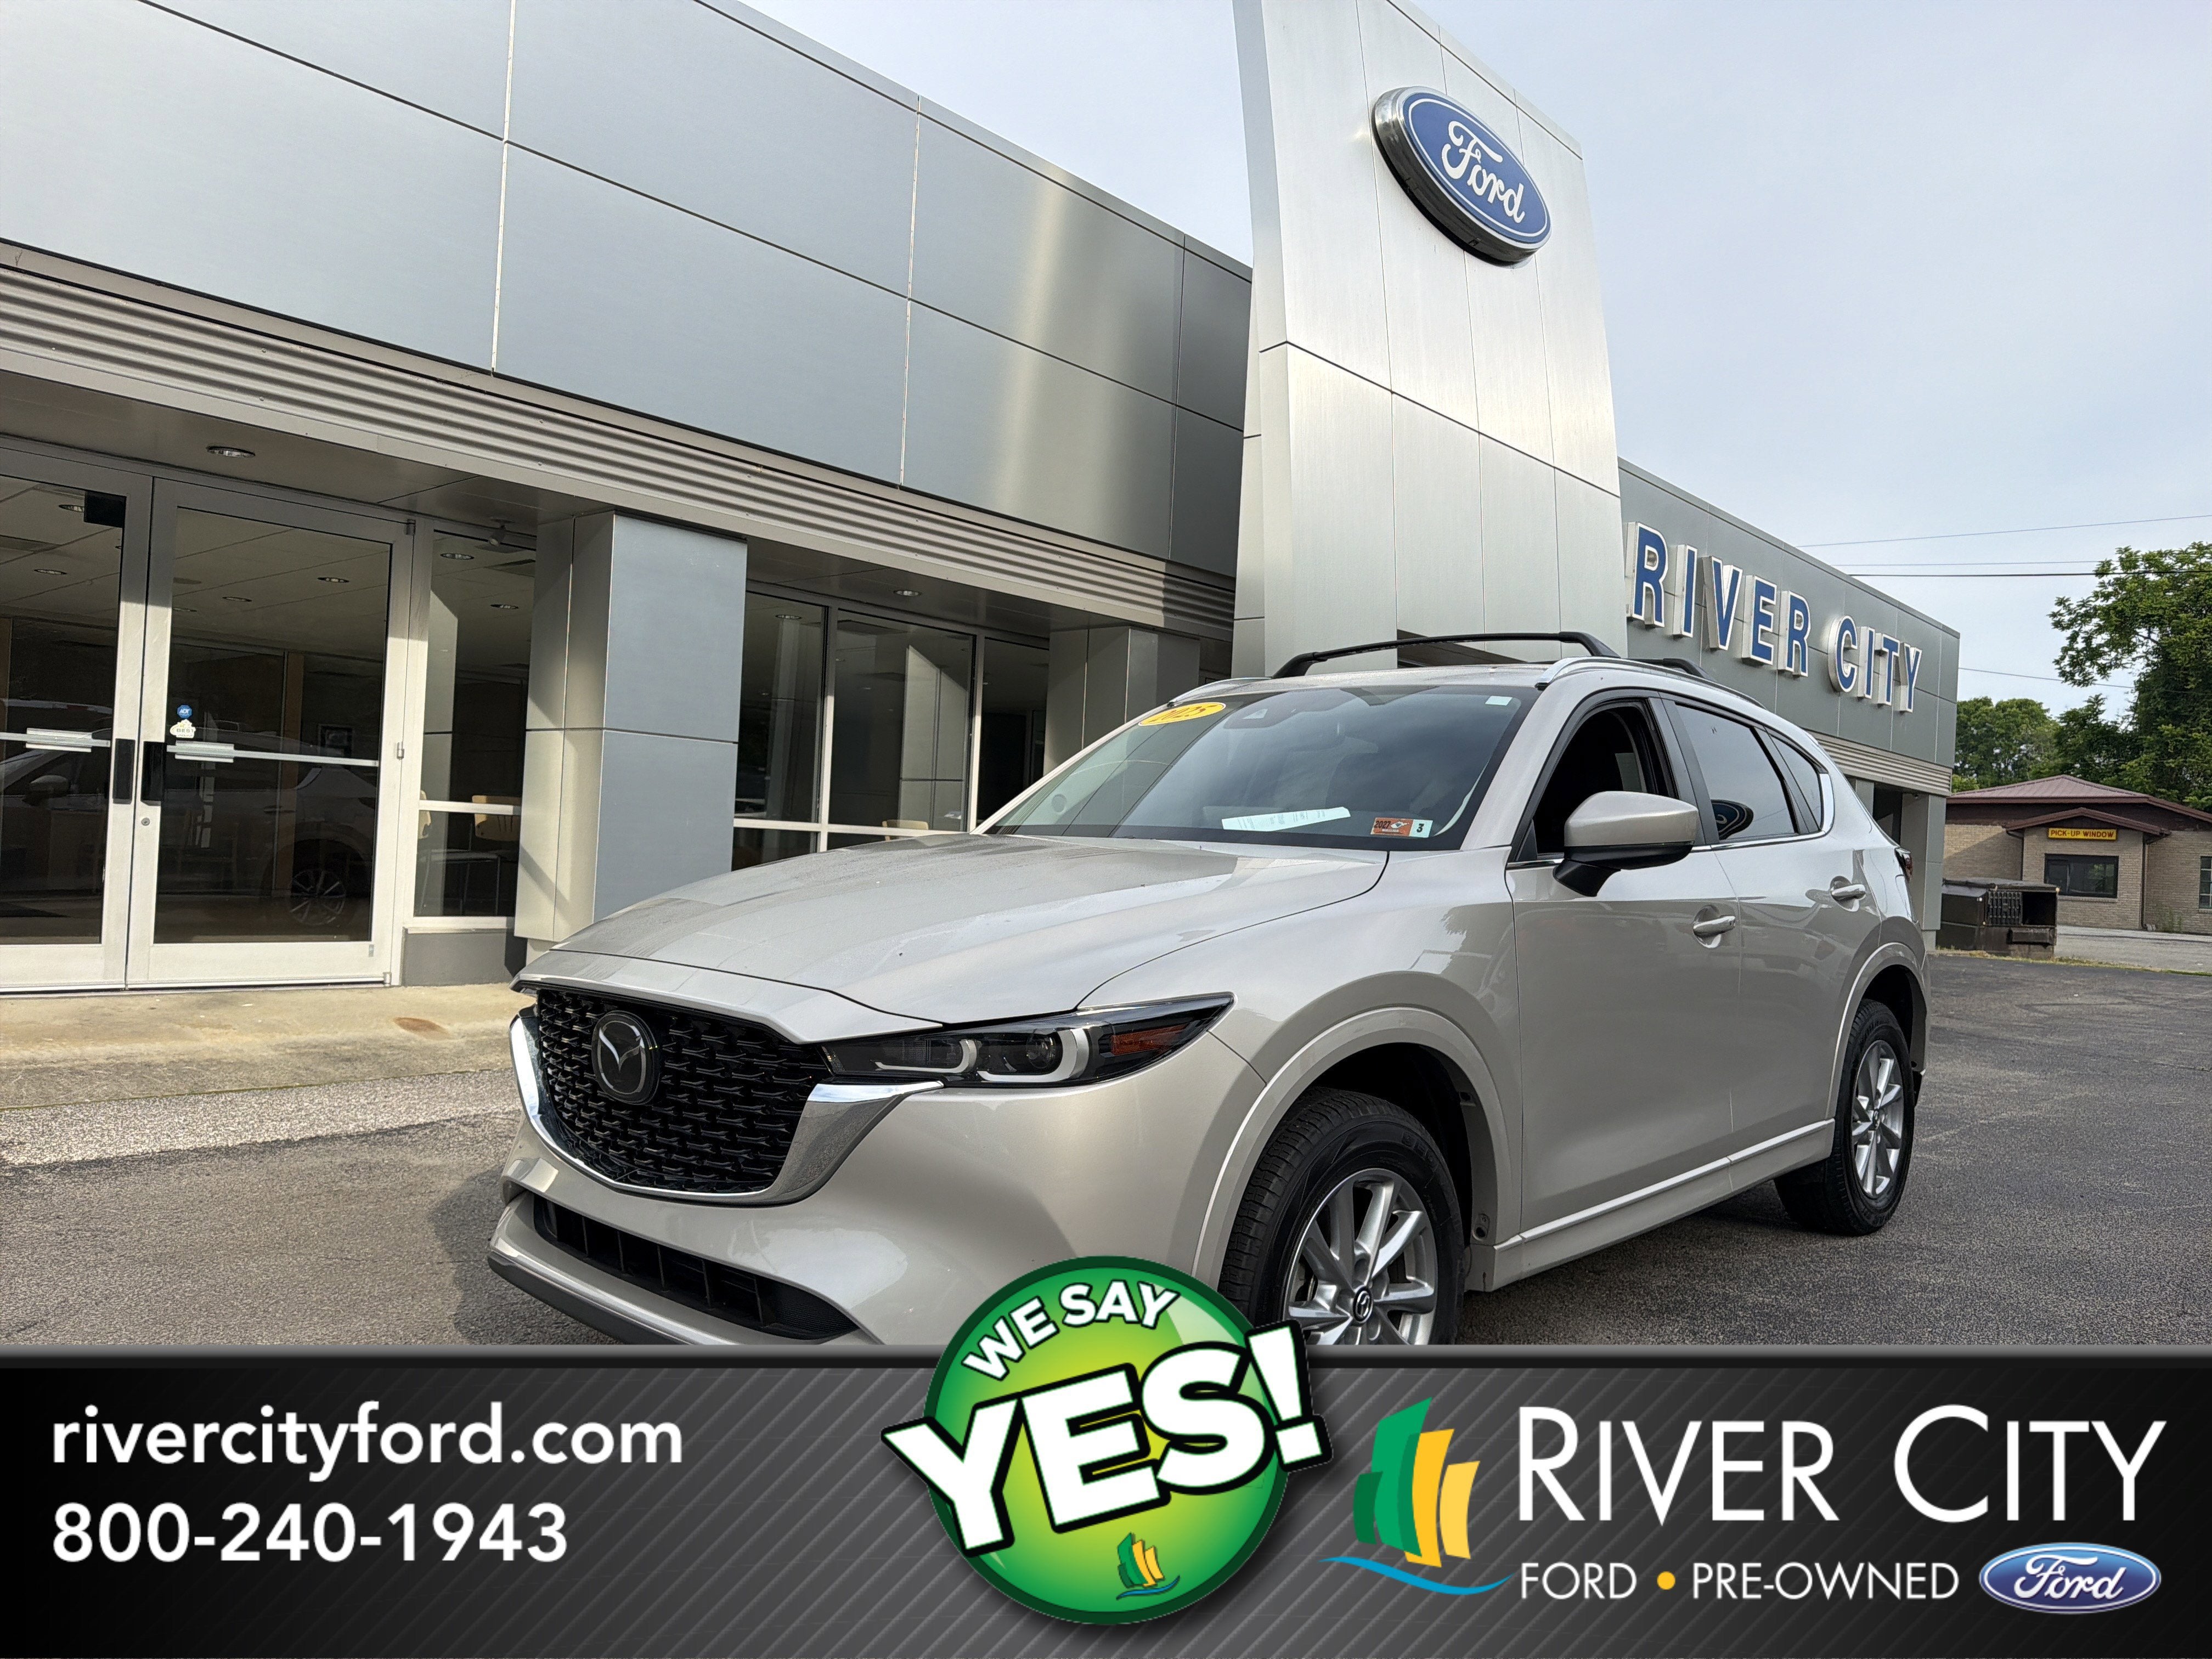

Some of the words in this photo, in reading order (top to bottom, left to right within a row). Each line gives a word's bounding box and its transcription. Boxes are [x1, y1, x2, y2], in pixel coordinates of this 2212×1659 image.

[1441, 121, 1525, 223] Ford
[1627, 522, 1810, 677] RIVER
[1829, 616, 1922, 713] CITY
[1374, 820, 1391, 829] 2027
[1417, 823, 1424, 833] 3
